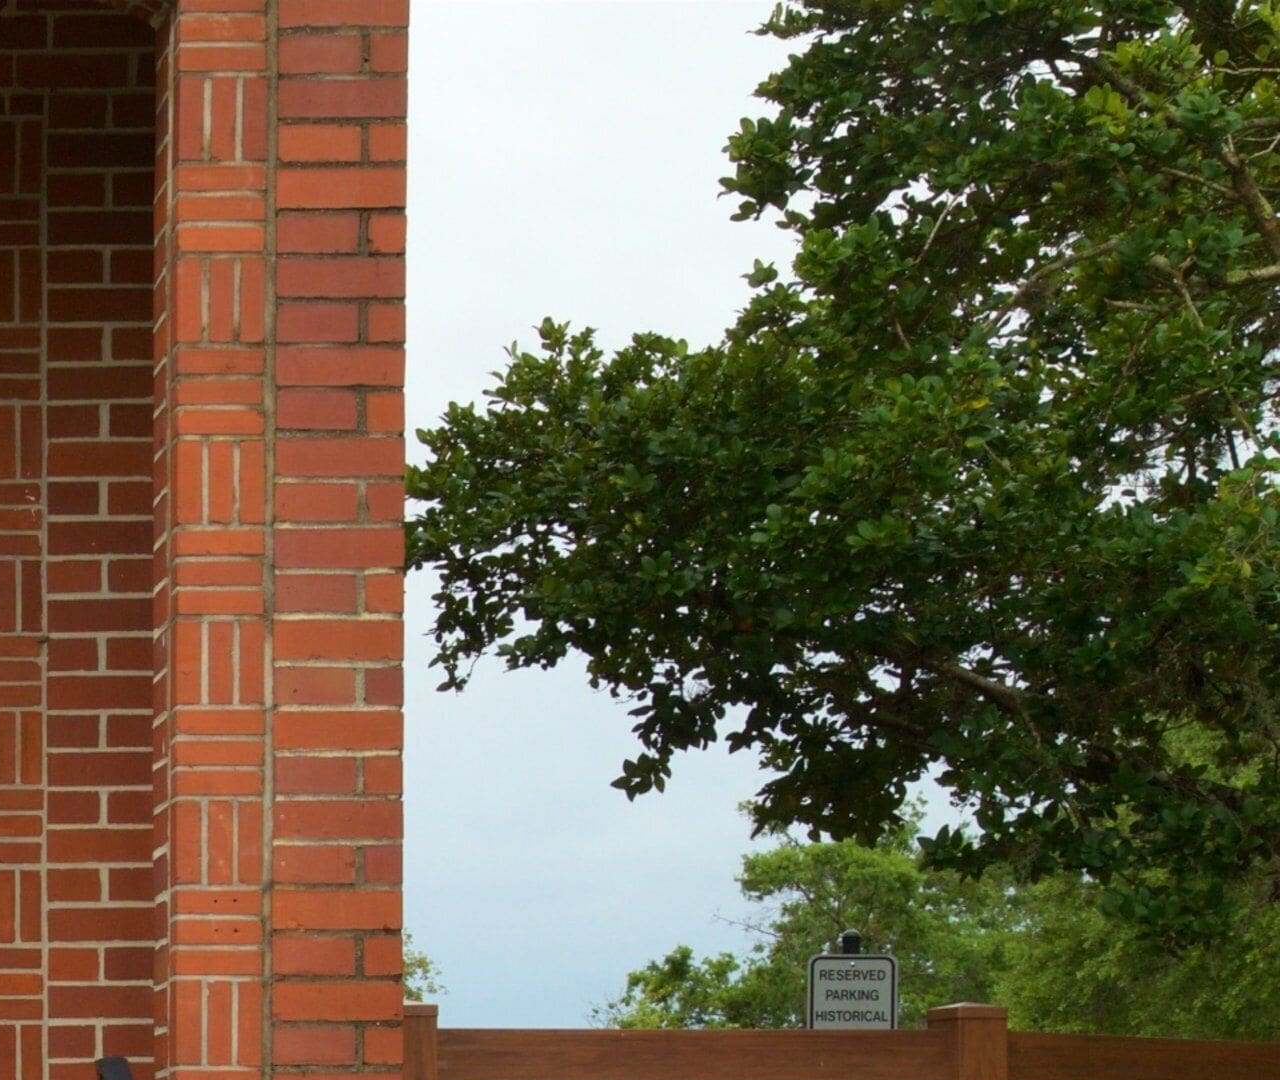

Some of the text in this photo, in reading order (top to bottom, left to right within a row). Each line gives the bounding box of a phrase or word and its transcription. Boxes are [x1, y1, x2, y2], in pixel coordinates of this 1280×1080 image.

[819, 969, 887, 981] RESERVED
[825, 989, 880, 1001] PARKING
[815, 1010, 888, 1022] HISTORICAL
